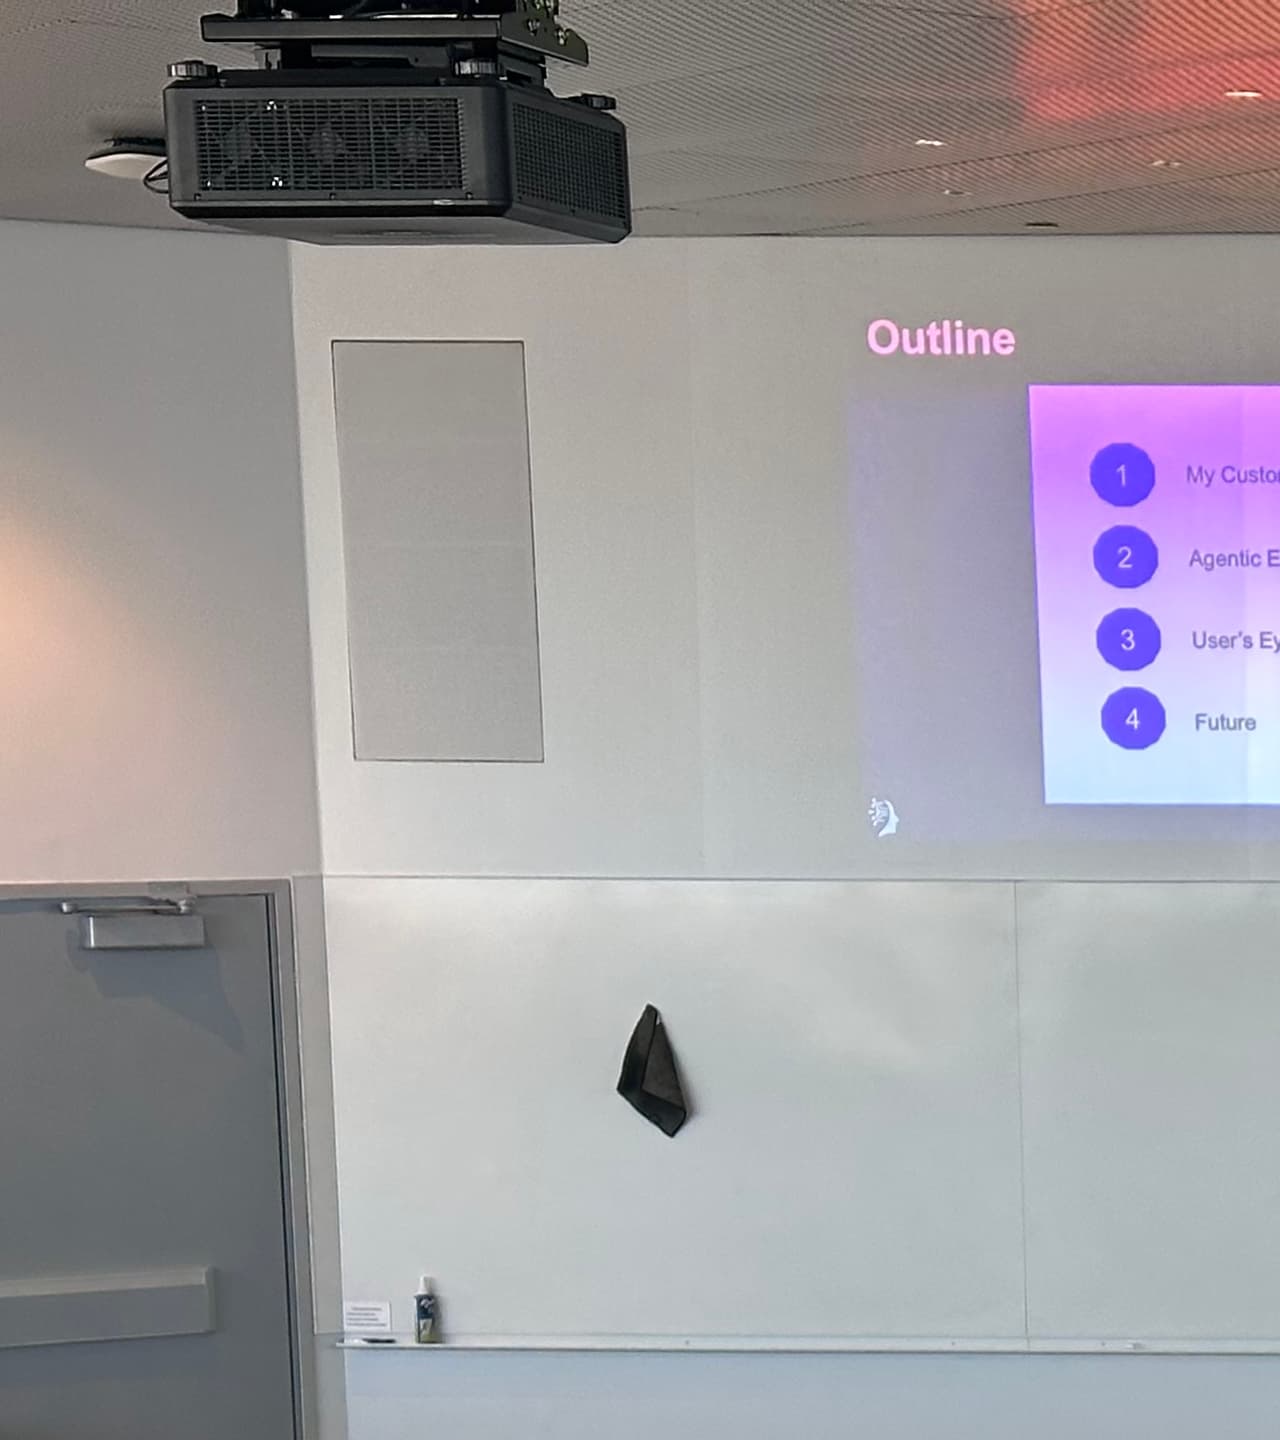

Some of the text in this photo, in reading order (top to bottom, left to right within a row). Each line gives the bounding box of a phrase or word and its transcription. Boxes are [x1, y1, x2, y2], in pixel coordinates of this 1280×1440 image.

[867, 319, 1016, 356] Outline
[1116, 464, 1127, 487] 1
[1186, 464, 1216, 489] My
[1117, 545, 1133, 569] 2
[1188, 548, 1262, 572] Agentic
[1120, 628, 1136, 651] 3
[1191, 630, 1254, 650] User's
[1125, 707, 1257, 732] 4 Future
